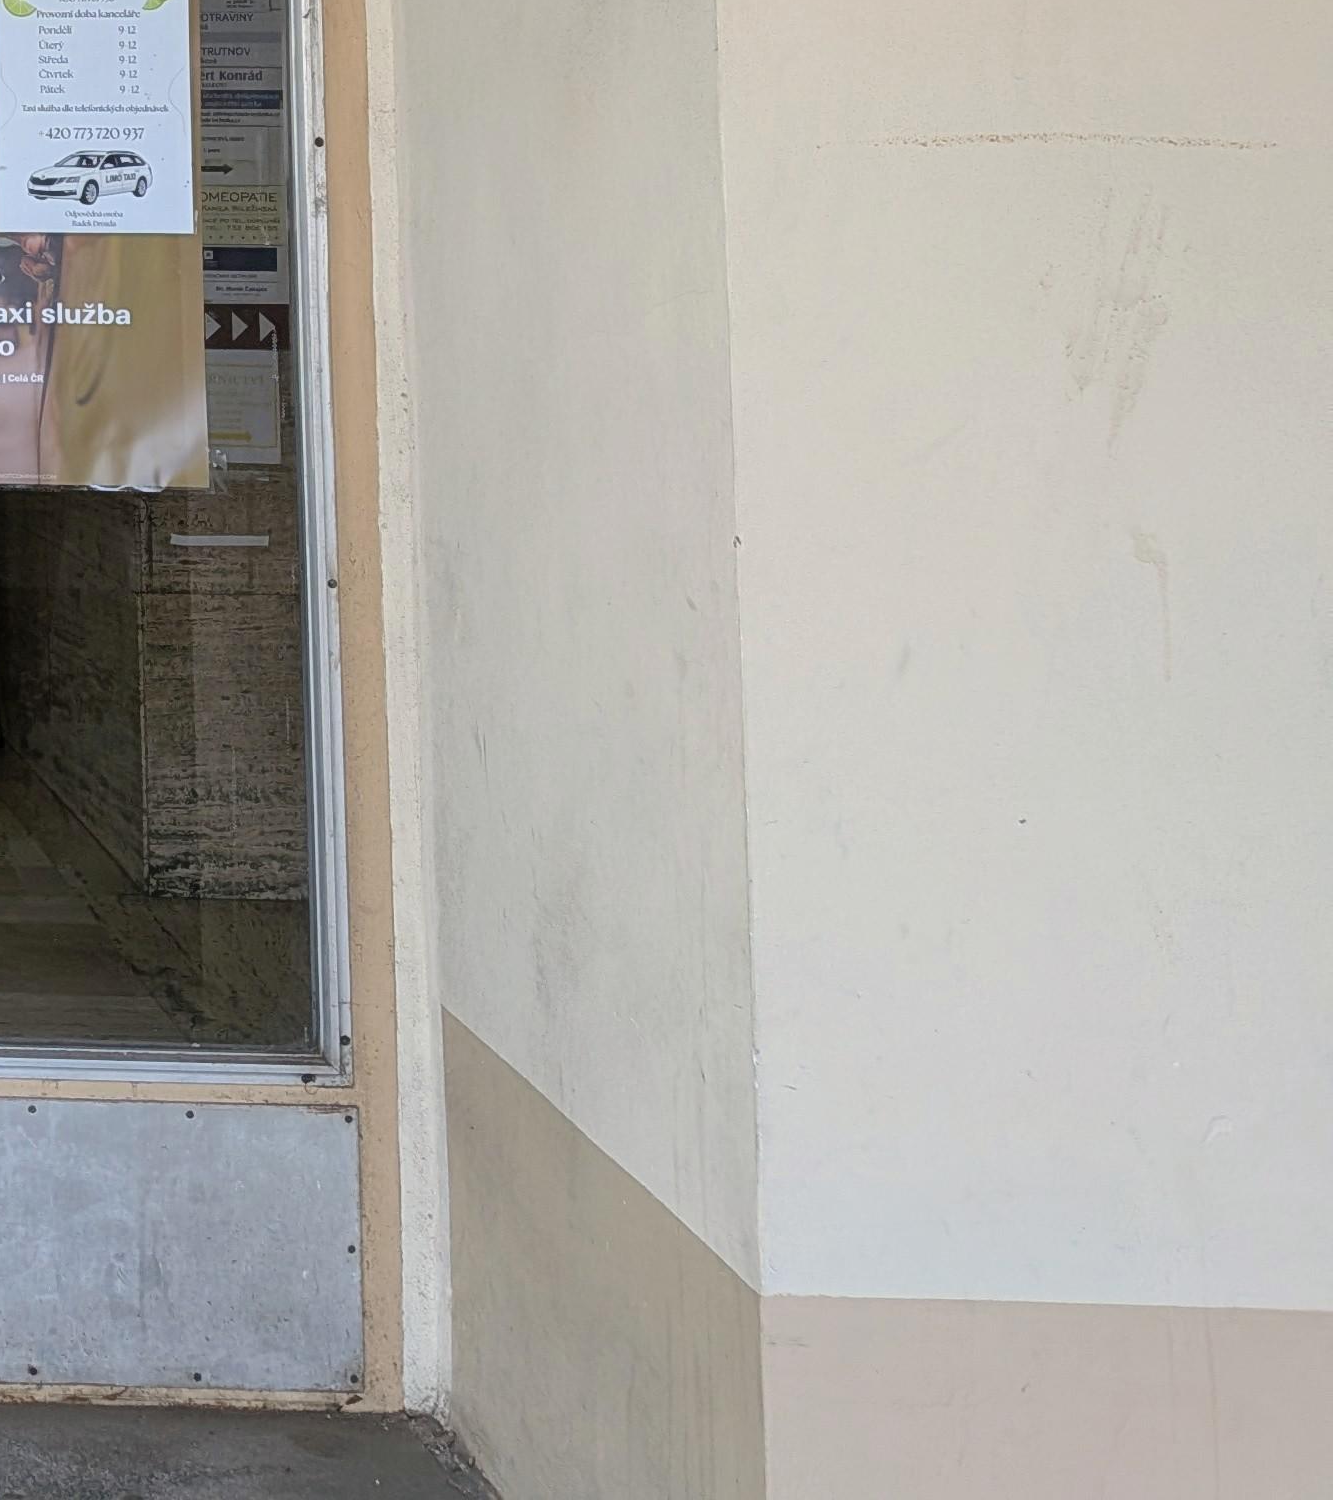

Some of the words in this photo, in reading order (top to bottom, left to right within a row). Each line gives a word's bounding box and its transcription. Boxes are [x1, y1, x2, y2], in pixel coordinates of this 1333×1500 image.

[200, 13, 253, 21] OTRAVINY
[38, 25, 73, 34] Pondělí
[38, 54, 69, 64] Středa
[40, 84, 65, 94] Pátek
[96, 128, 121, 140] 720
[123, 128, 145, 140] 937
[201, 192, 277, 202] OMEOPATIE
[41, 303, 131, 325] služba
